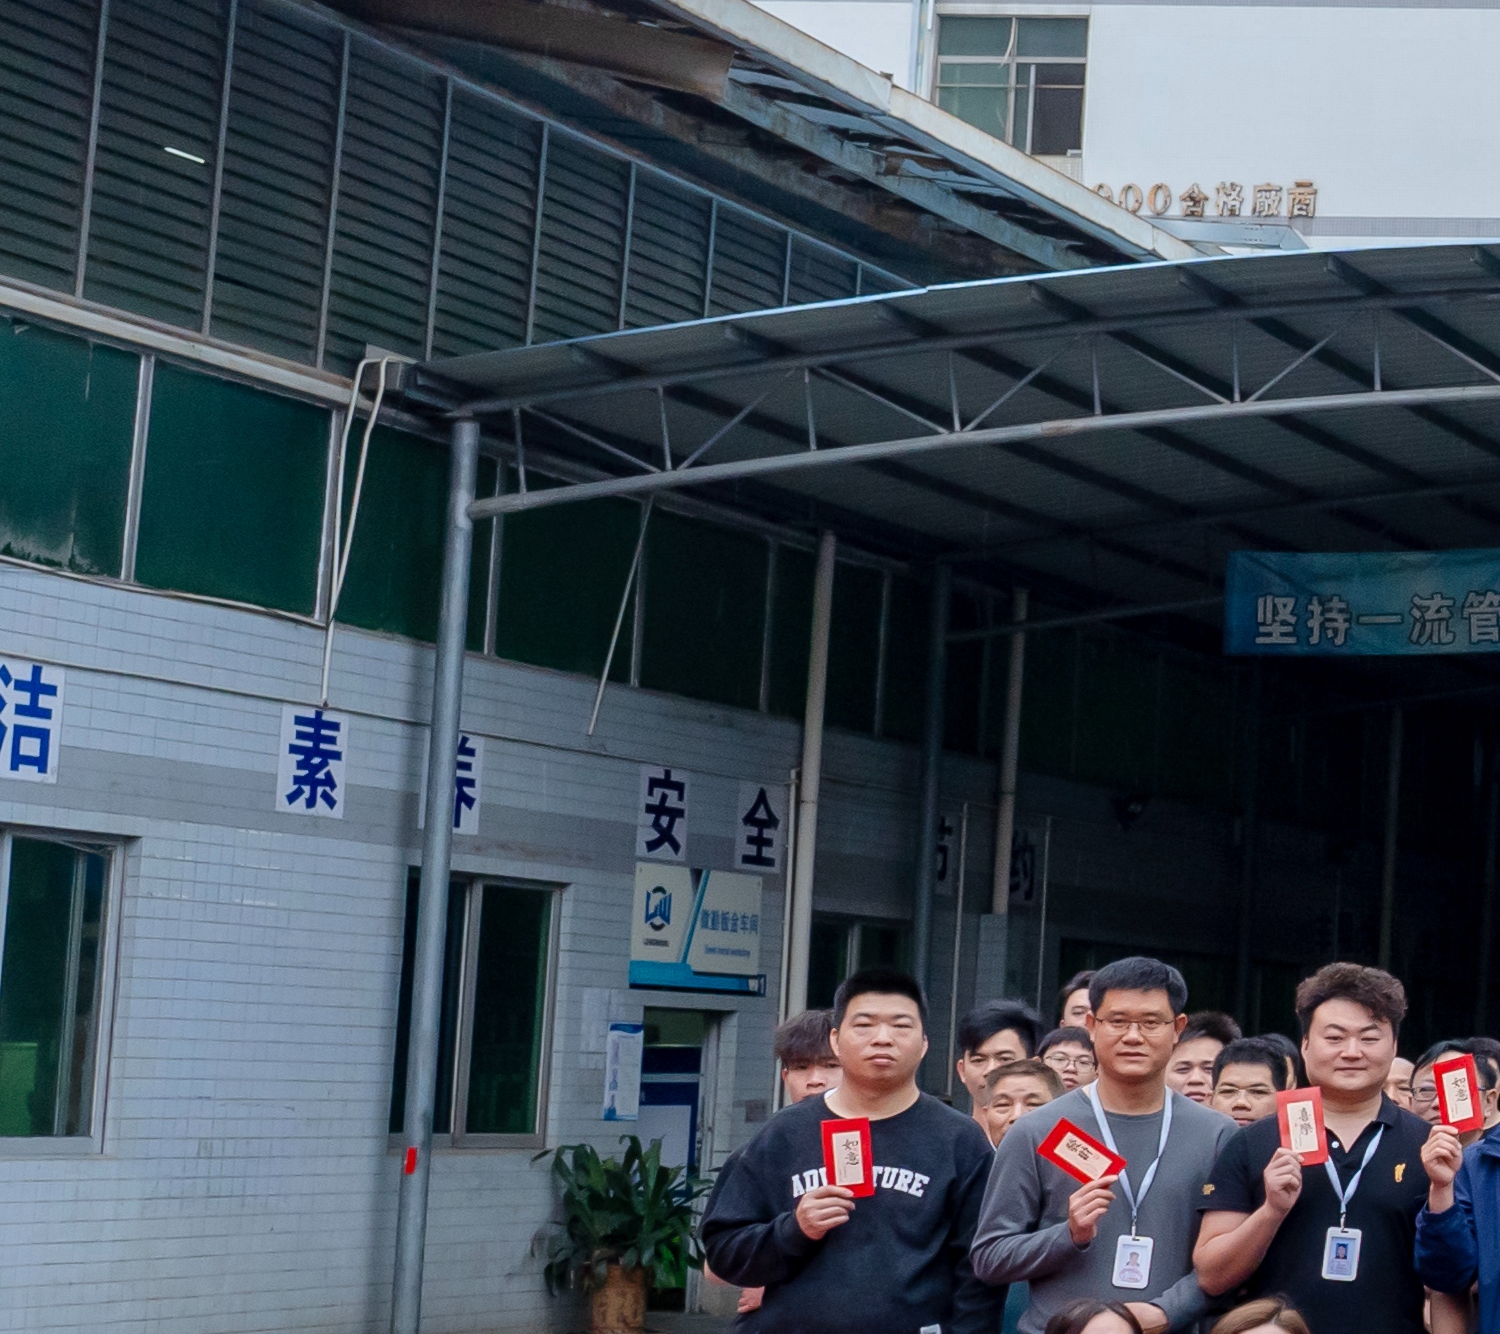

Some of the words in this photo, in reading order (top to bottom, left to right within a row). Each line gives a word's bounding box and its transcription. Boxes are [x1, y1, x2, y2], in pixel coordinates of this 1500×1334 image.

[643, 768, 782, 868] 安全
[1451, 1075, 1468, 1103] 如意
[842, 1139, 859, 1167] 如意
